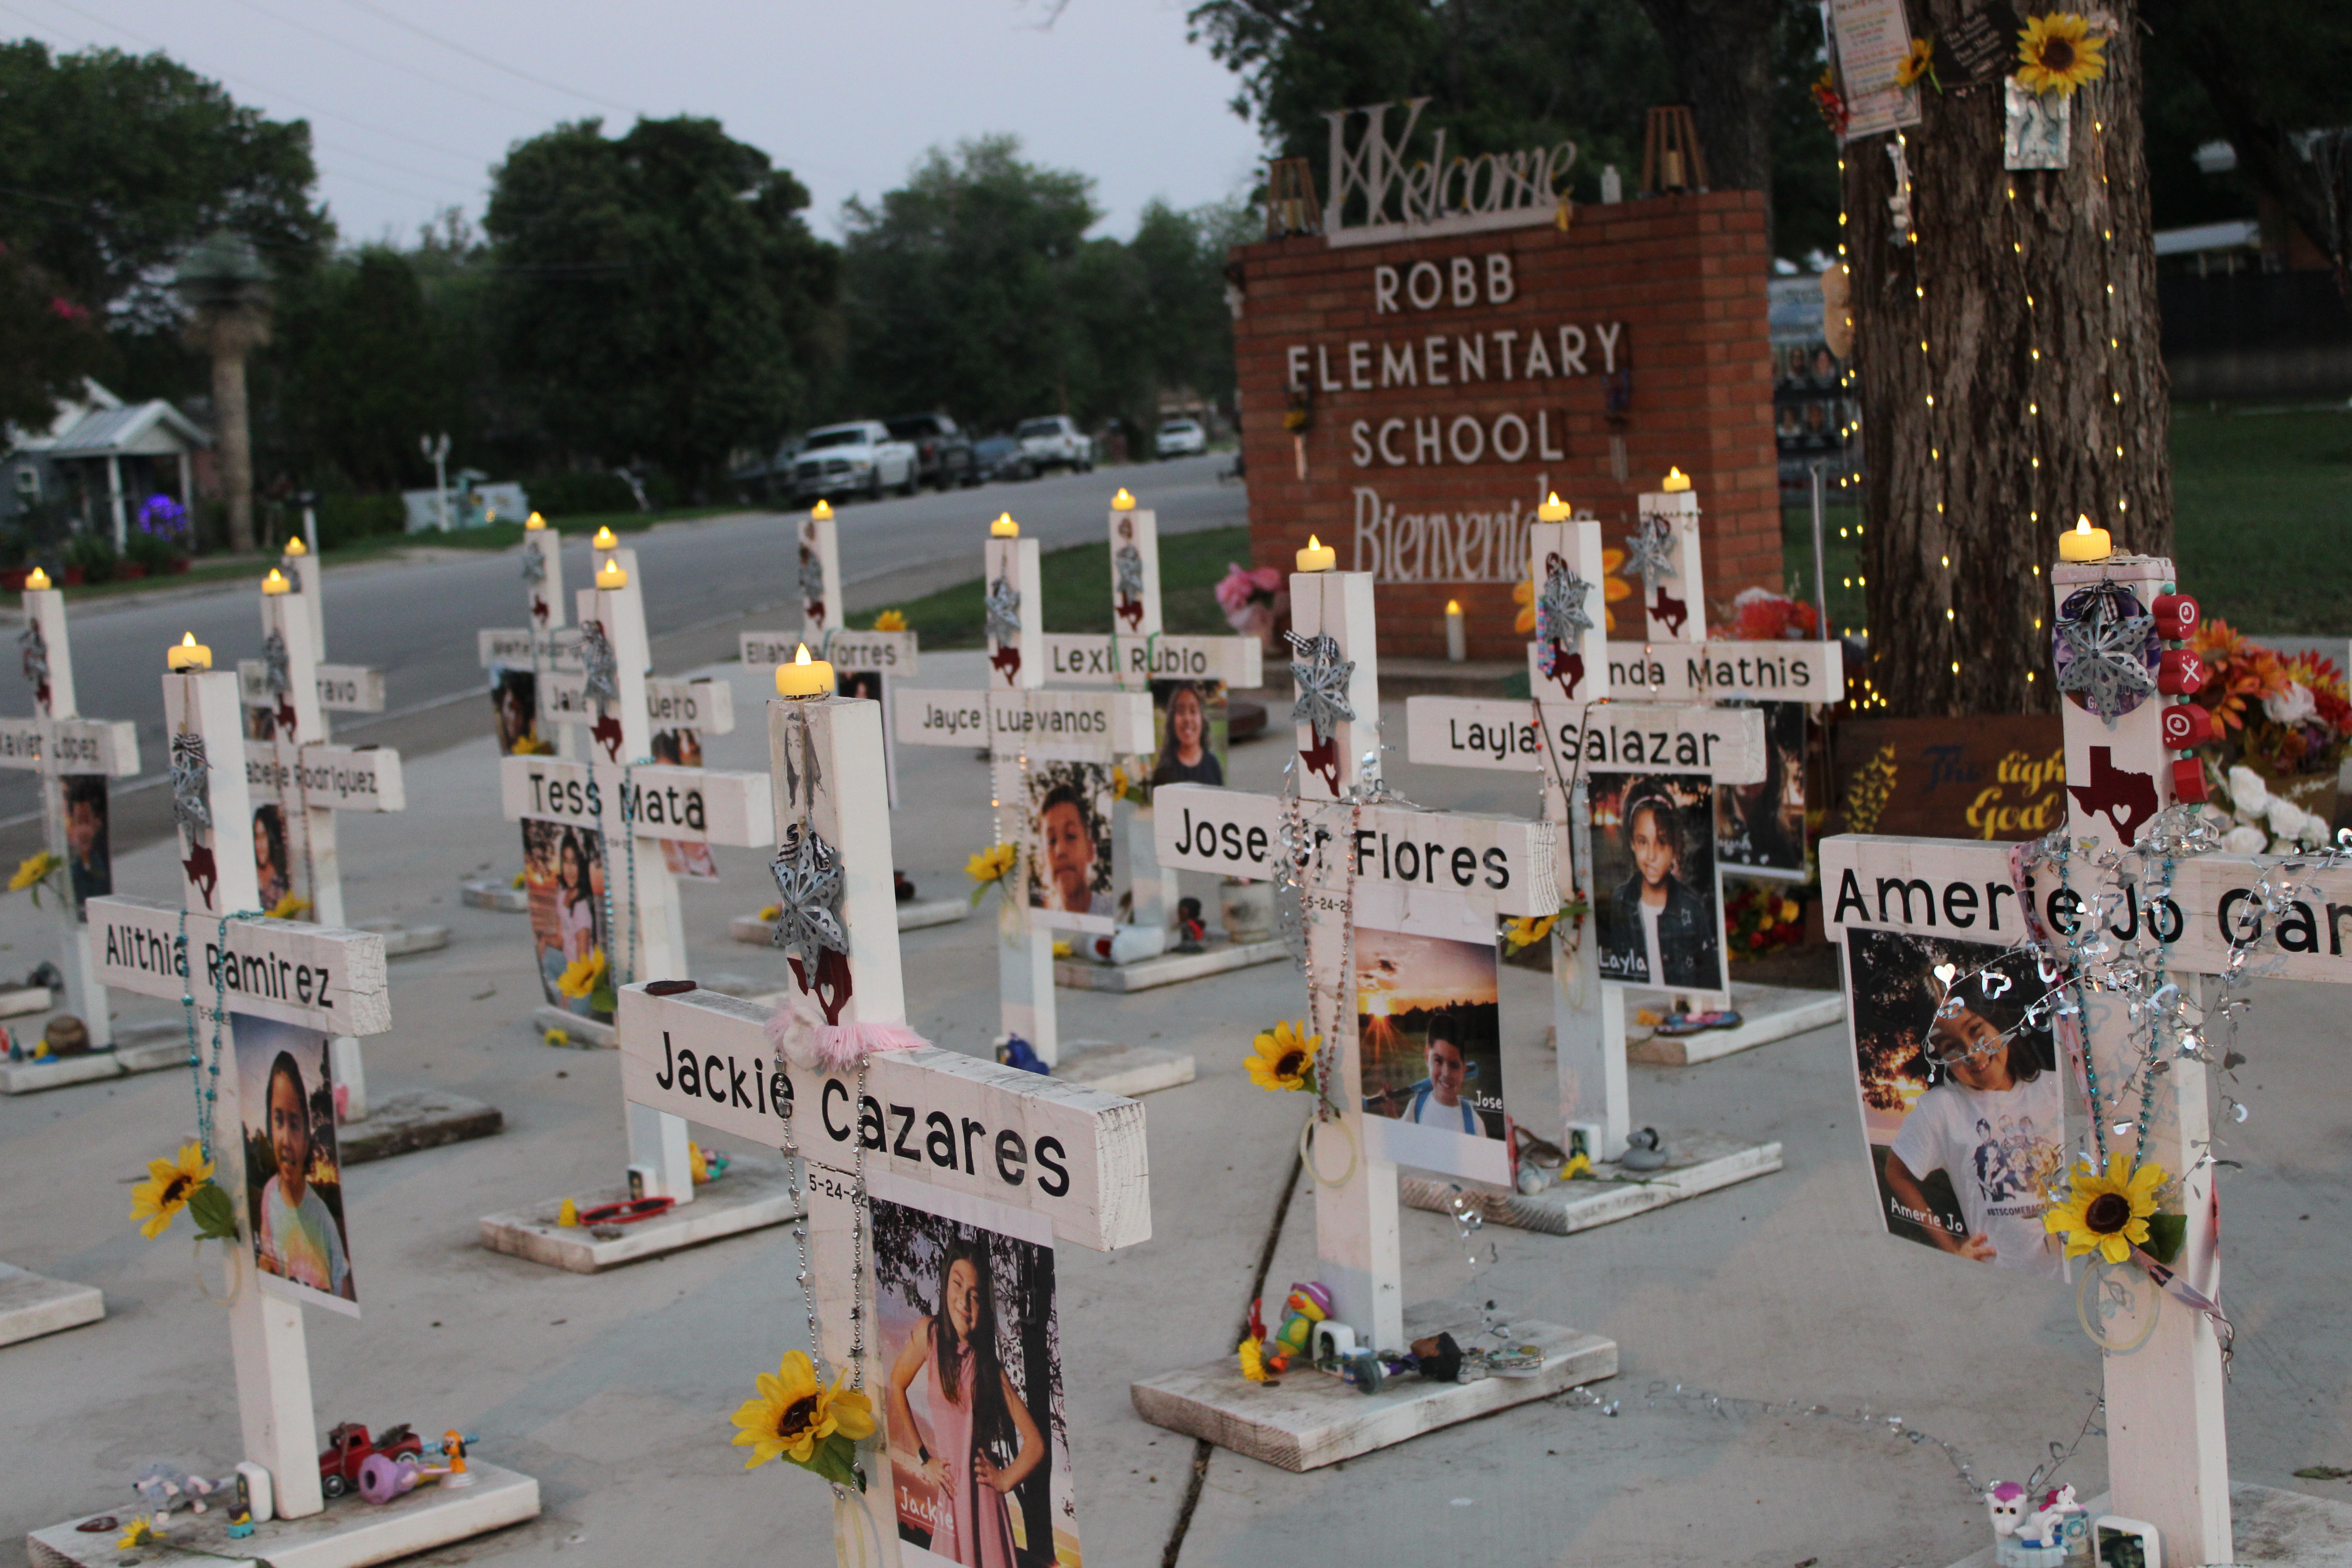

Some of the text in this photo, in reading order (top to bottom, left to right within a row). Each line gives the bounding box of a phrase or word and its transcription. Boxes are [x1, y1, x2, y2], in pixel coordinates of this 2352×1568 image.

[1322, 97, 1577, 231] Welcome
[1374, 252, 1515, 314] ROBB
[1287, 321, 1621, 392] ELEMENTARY
[1351, 409, 1564, 467] SCHOOL
[1054, 646, 1207, 674] Lexi Rubio
[1687, 657, 1810, 687] Mathis
[316, 680, 358, 702] ravo
[923, 704, 1106, 734] Jayce Luevanos
[1450, 719, 1720, 766] Layla Salazar
[1998, 750, 2065, 797] ligh
[529, 774, 705, 830] Tess Mata
[1966, 787, 2060, 840] God
[1175, 808, 1268, 862] Jose
[1356, 829, 1510, 890] Flores
[1308, 895, 1352, 913] 5-24-2
[2110, 884, 2183, 943] Jo
[105, 924, 333, 1008] Alithia Ramirez
[1598, 946, 1648, 975] Layla
[656, 1031, 1070, 1197] Jackie Cazares
[1475, 1090, 1503, 1109] Jose
[1891, 1196, 1964, 1232] Amerie Jo
[900, 1485, 955, 1530] Jackie
